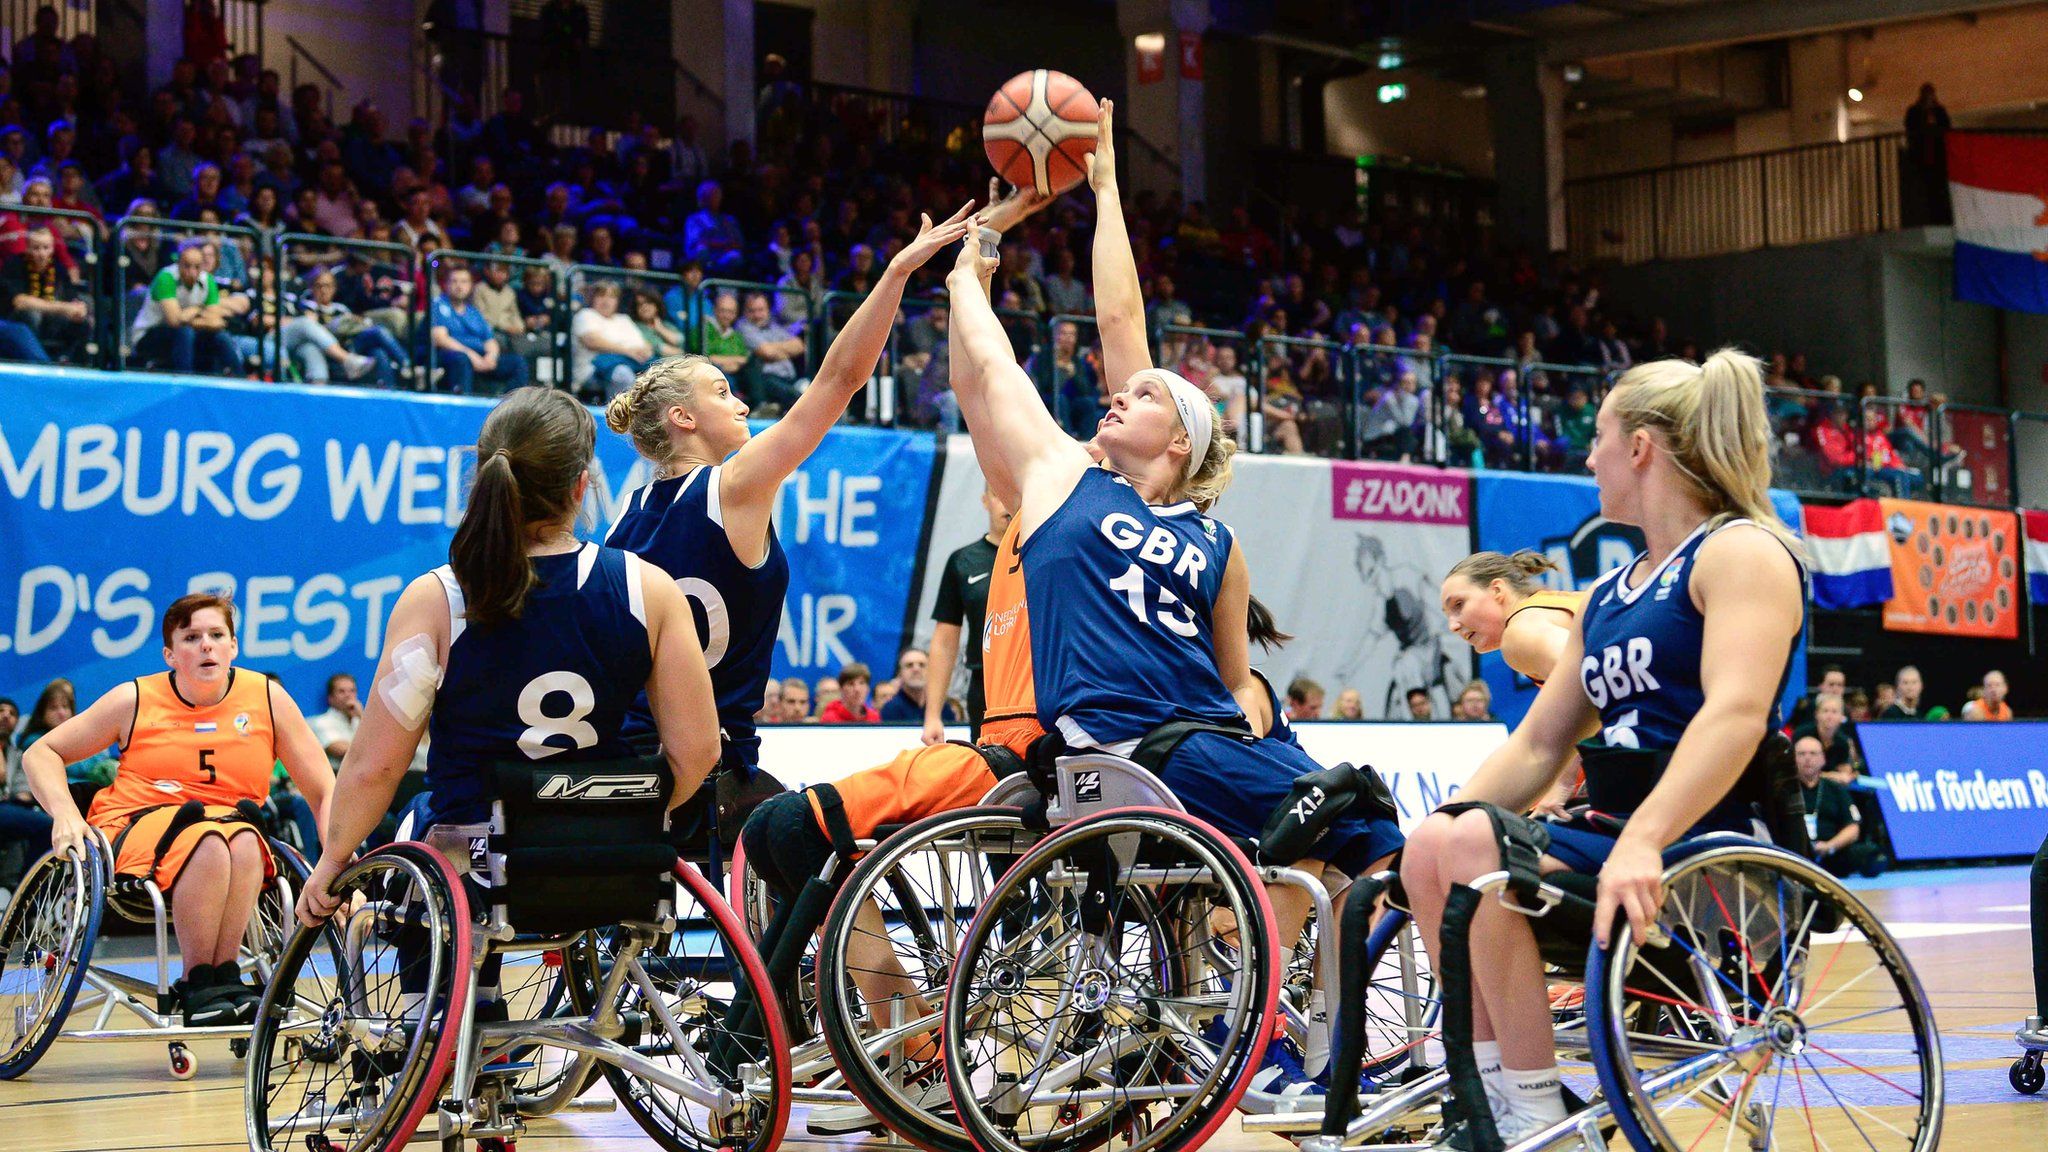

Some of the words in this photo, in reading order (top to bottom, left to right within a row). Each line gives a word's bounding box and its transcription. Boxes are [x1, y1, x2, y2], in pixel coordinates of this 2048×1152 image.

[0, 422, 302, 521] MBURG
[1344, 479, 1462, 518] #ZADONK
[1100, 512, 1207, 590] GBR
[0, 565, 155, 659] D'S
[1109, 563, 1199, 638] 15
[1581, 636, 1661, 709] GBR
[517, 670, 599, 760] 8
[199, 749, 216, 785] 5
[1885, 769, 1936, 812] Wir
[1935, 768, 2031, 811] fördern
[2027, 769, 2048, 808] R
